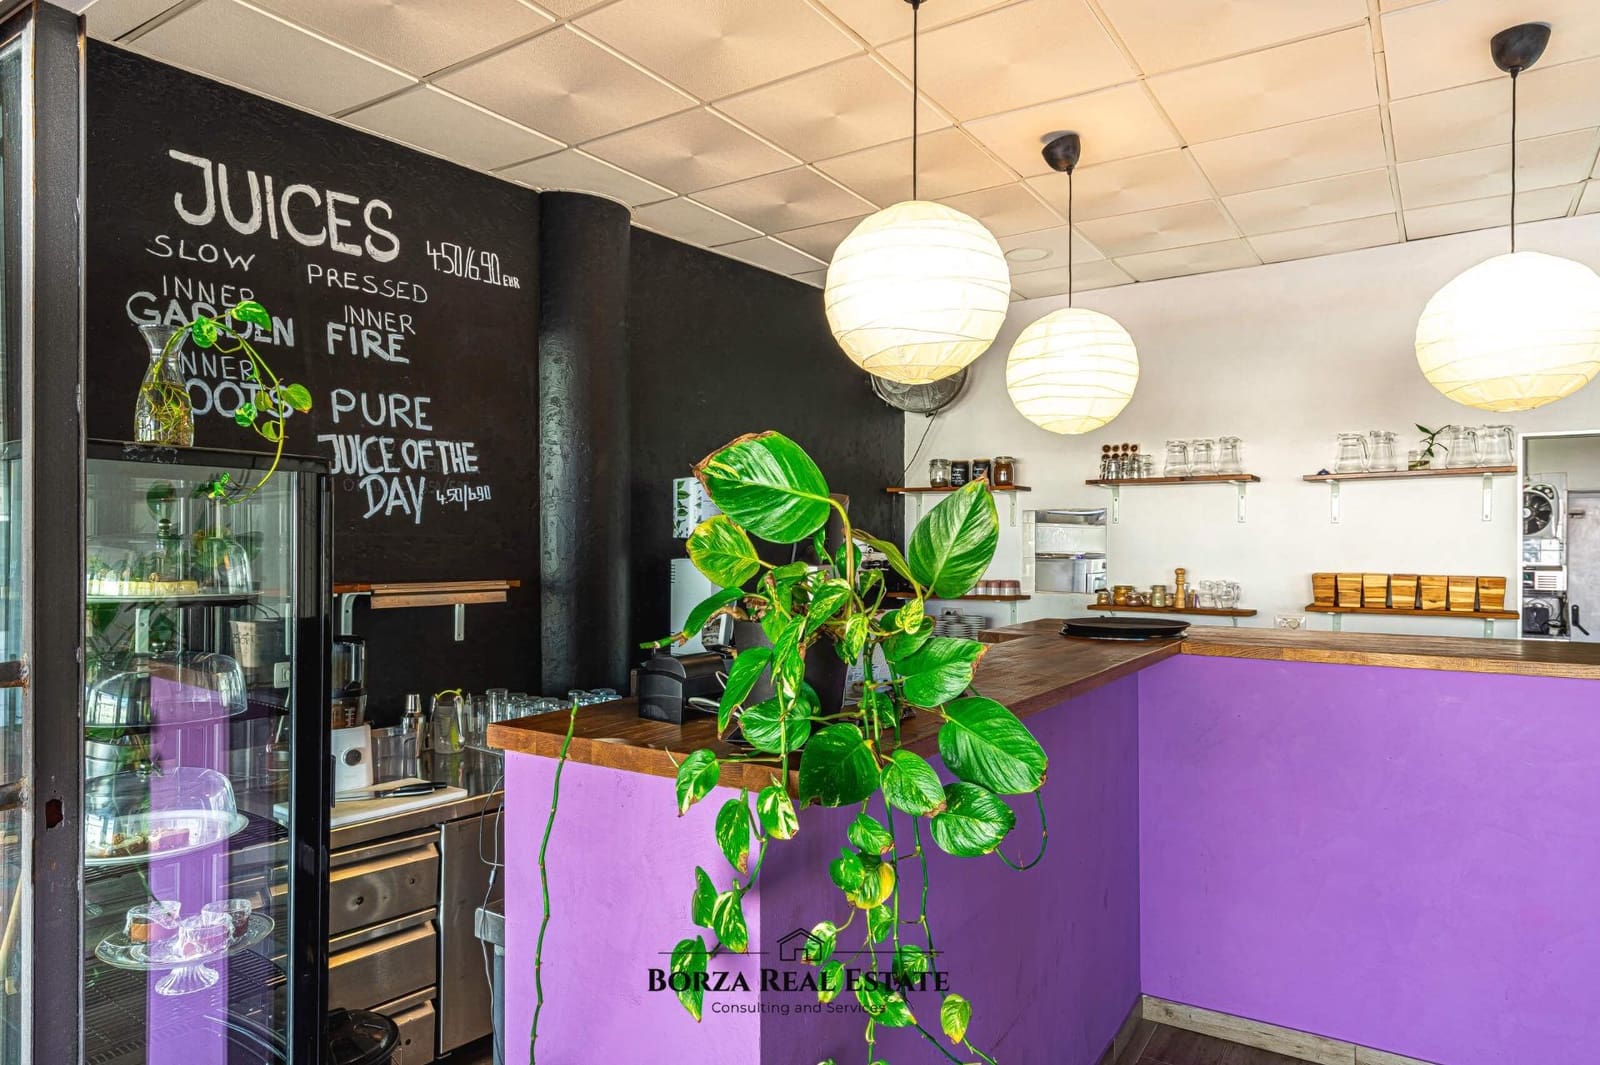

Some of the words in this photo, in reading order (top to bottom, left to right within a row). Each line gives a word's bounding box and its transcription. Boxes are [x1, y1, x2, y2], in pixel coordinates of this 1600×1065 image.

[169, 149, 400, 263] JUICES
[146, 235, 255, 272] SLOW
[308, 264, 428, 303] PRESSED
[503, 274, 520, 289] EUR
[163, 275, 254, 307] INNER
[344, 305, 416, 335] INNER
[327, 322, 410, 364] FIRE
[180, 351, 254, 383] NNER
[186, 378, 294, 418] OOTS
[331, 389, 433, 431] PURE
[317, 434, 400, 476] JUICE
[401, 438, 434, 470] OF
[435, 440, 479, 475] THE
[359, 474, 426, 524] DAY
